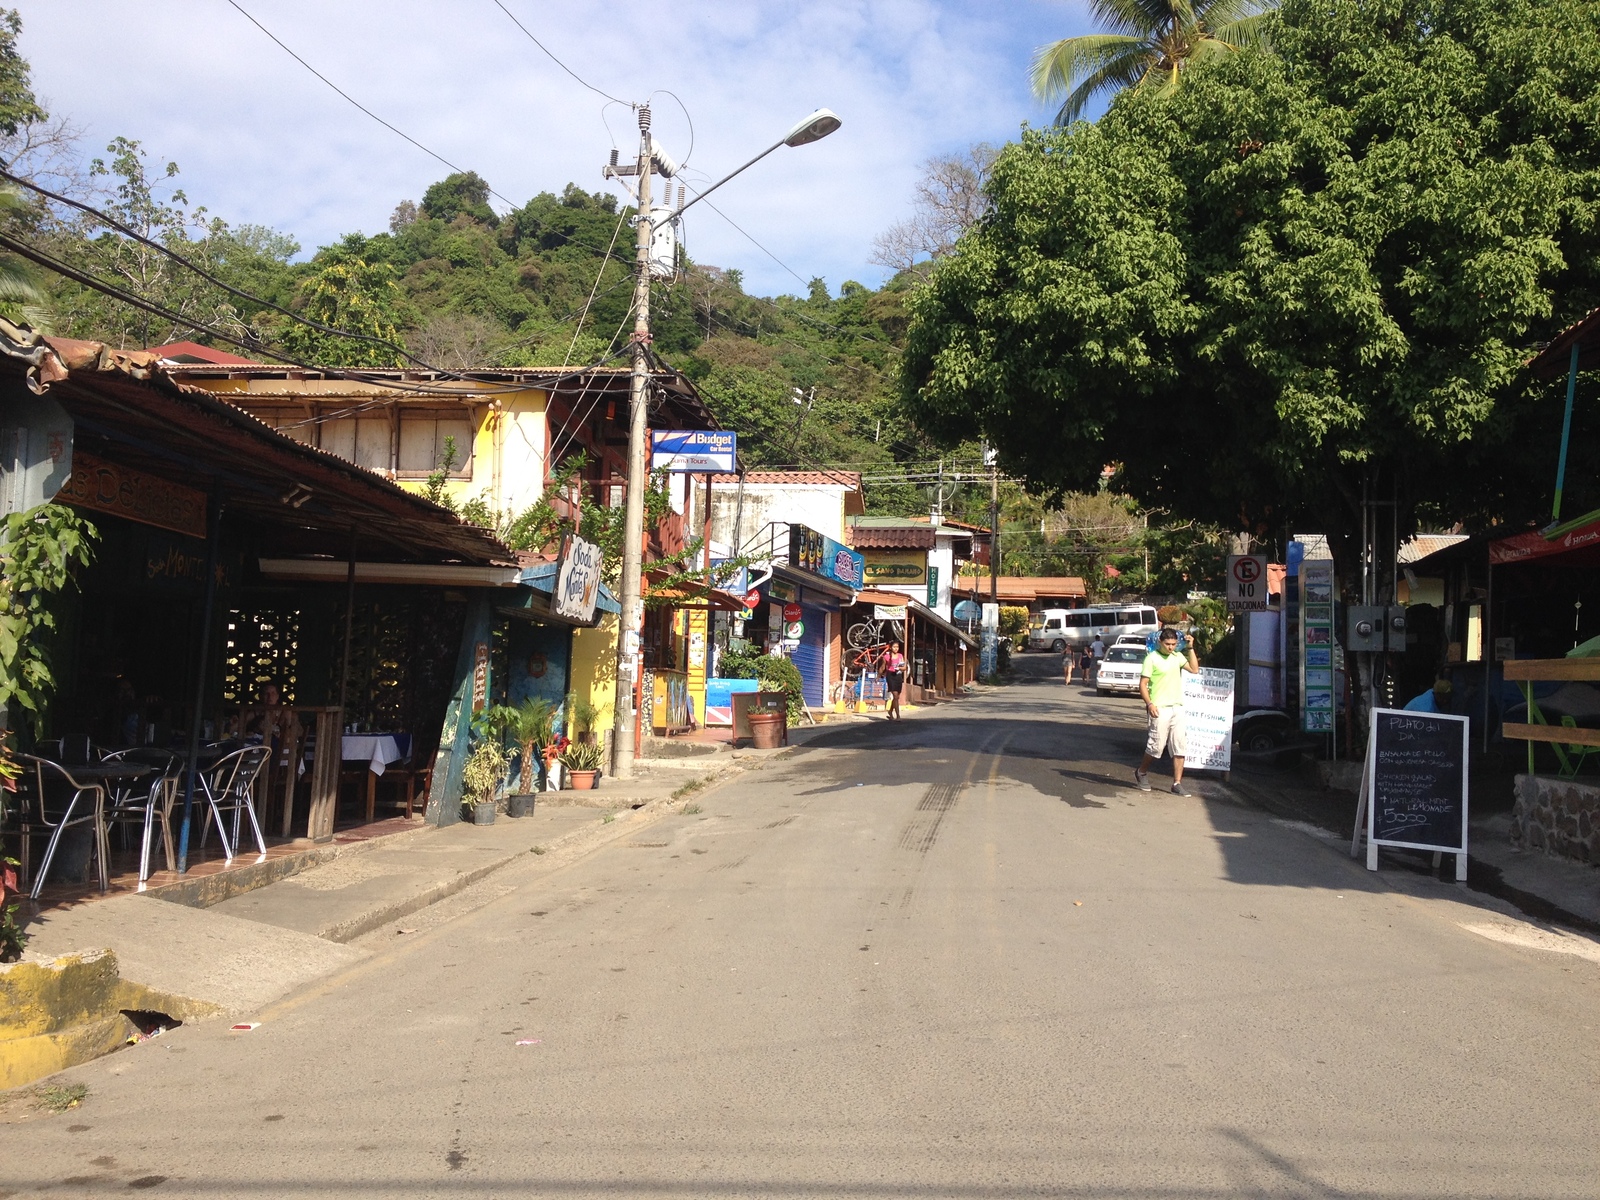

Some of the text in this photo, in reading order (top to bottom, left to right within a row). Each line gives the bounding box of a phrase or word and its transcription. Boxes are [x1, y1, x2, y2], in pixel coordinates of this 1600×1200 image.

[697, 433, 732, 446] Budget
[690, 457, 708, 465] Tours
[1572, 531, 1600, 545] HONDA
[573, 542, 592, 569] Soda
[1239, 583, 1254, 597] NO
[1228, 601, 1266, 610] ESTACIONAR
[1205, 668, 1235, 680] TOURS
[1200, 712, 1226, 722] FISHING
[1389, 717, 1440, 732] PLATO del
[1412, 750, 1421, 758] DE
[1424, 750, 1446, 758] POLLO
[1200, 757, 1231, 769] LESSONS
[1390, 797, 1426, 805] NATURAL
[1407, 803, 1454, 813] LEMONADE
